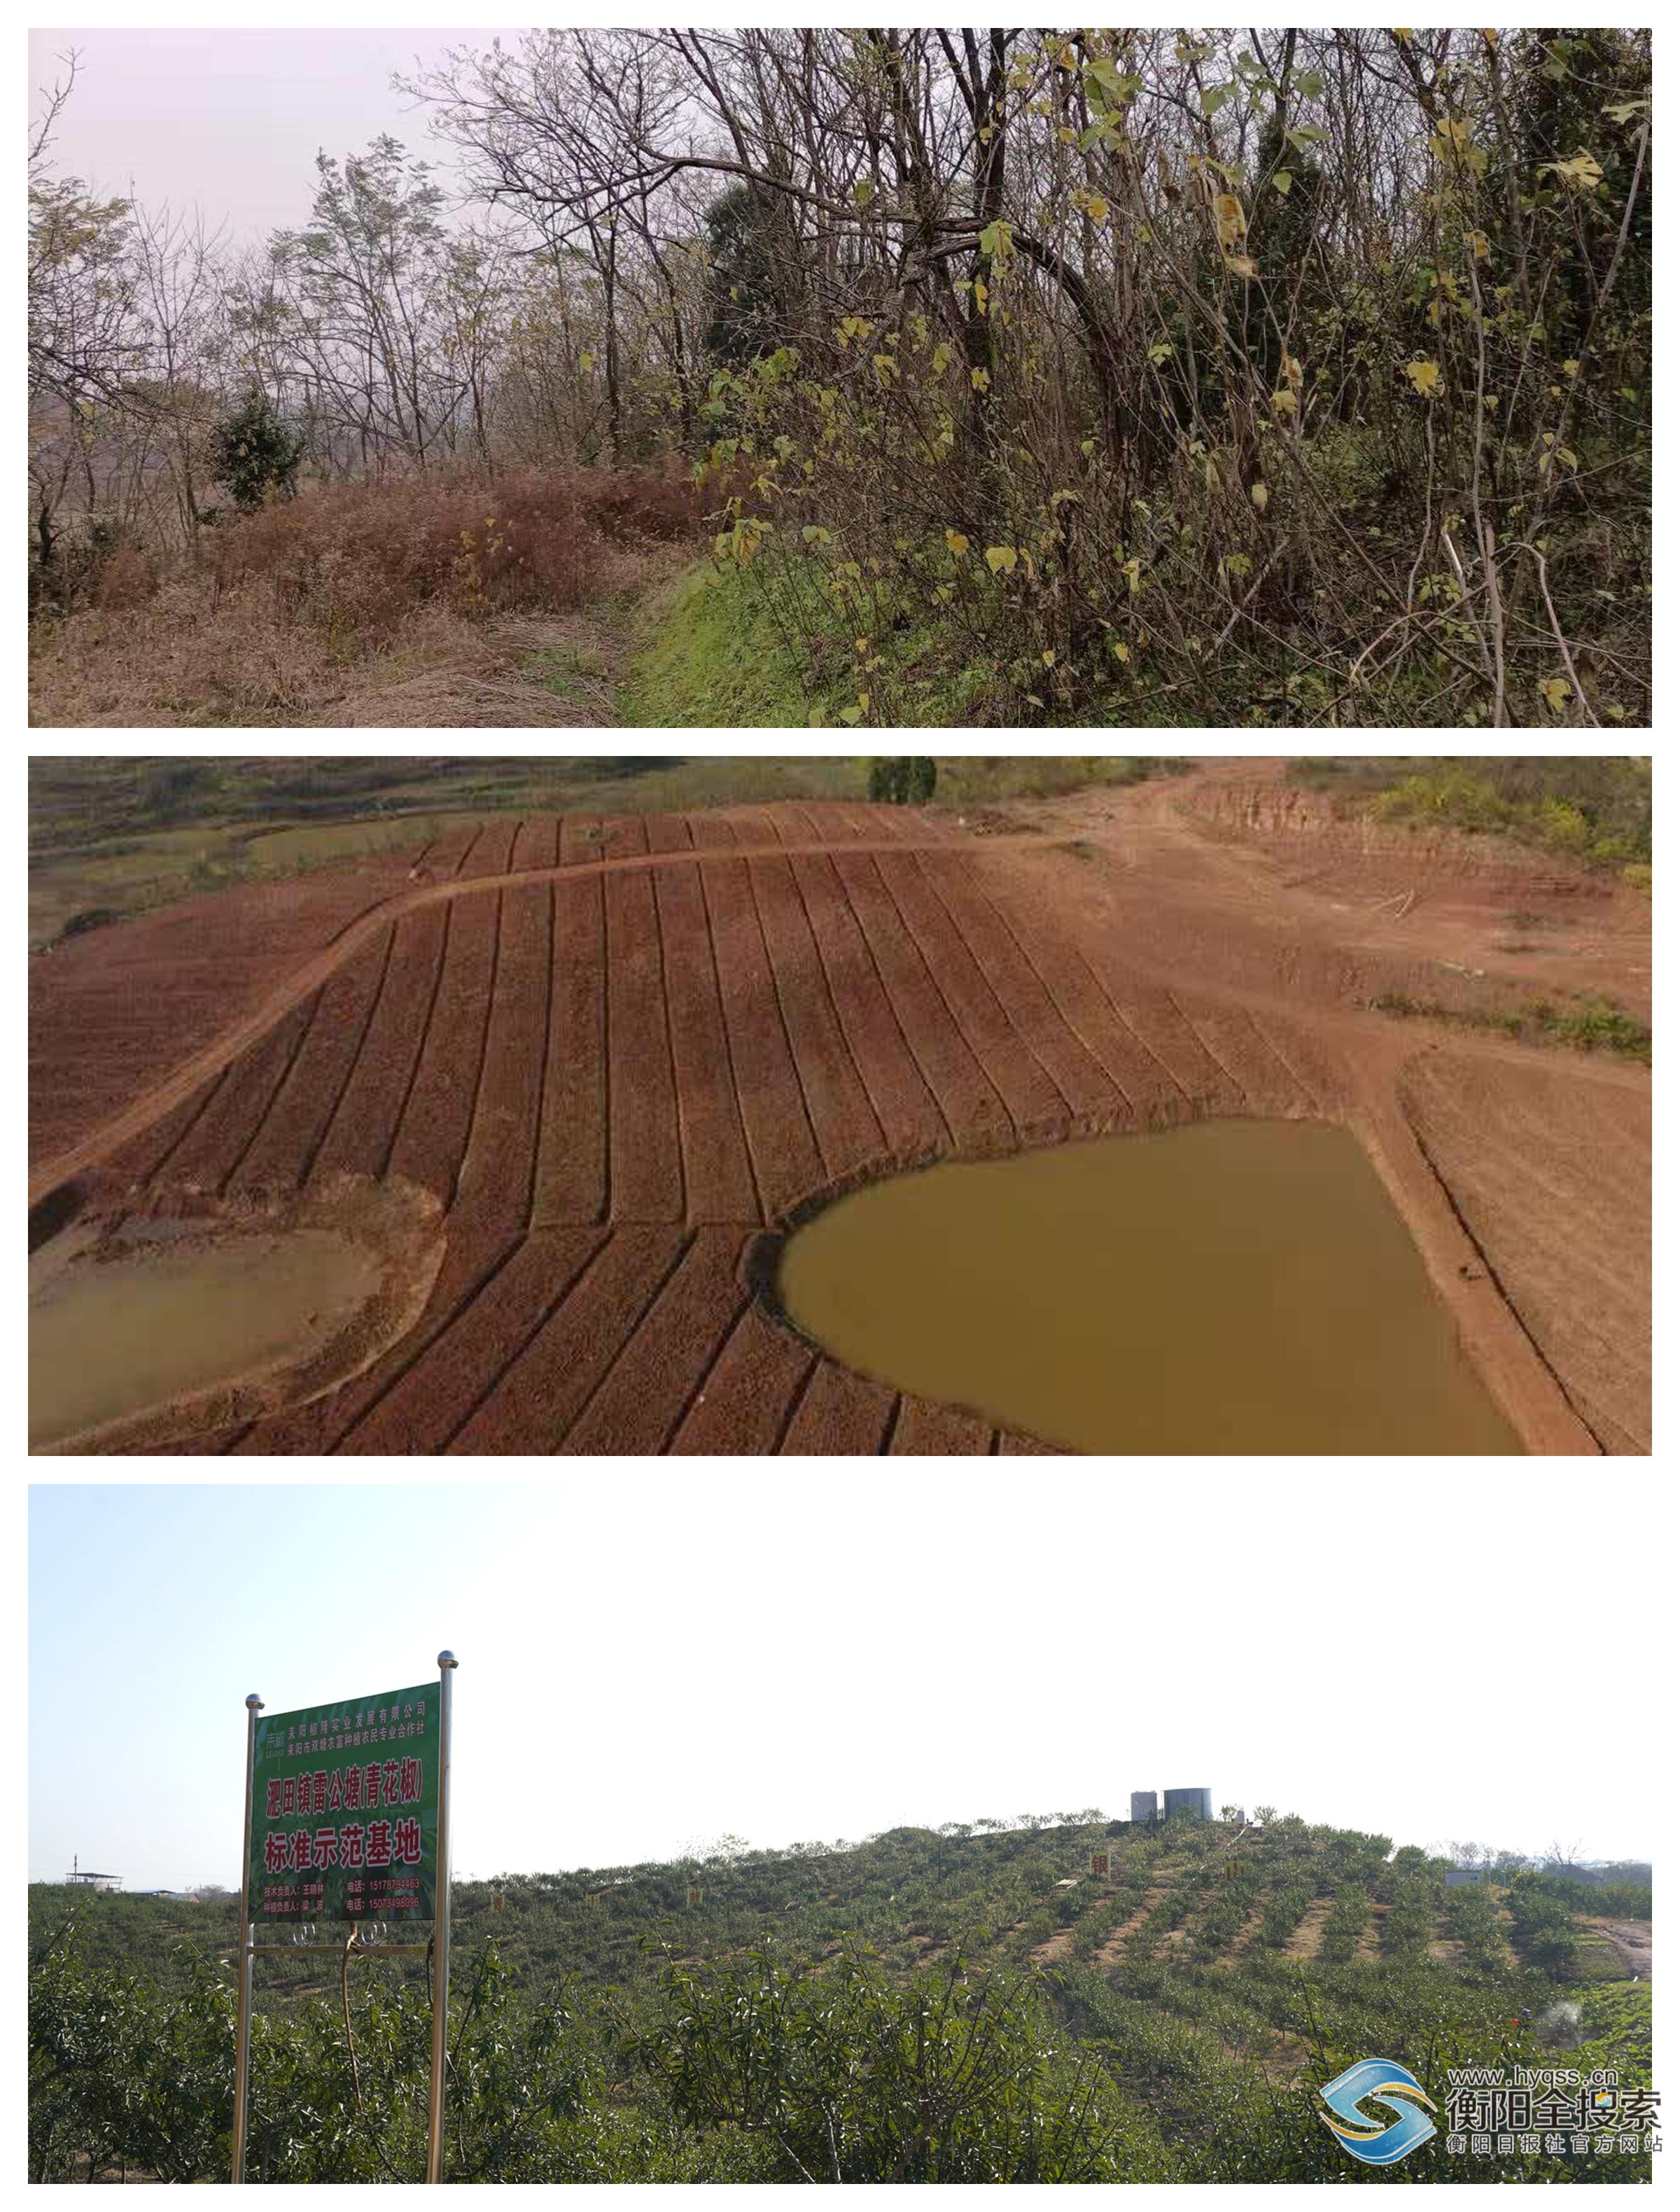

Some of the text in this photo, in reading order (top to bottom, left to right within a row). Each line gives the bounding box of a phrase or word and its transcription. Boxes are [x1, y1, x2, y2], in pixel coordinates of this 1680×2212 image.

[264, 1817, 422, 1874] 标准示范基地
[1092, 1855, 1108, 1873] 银
